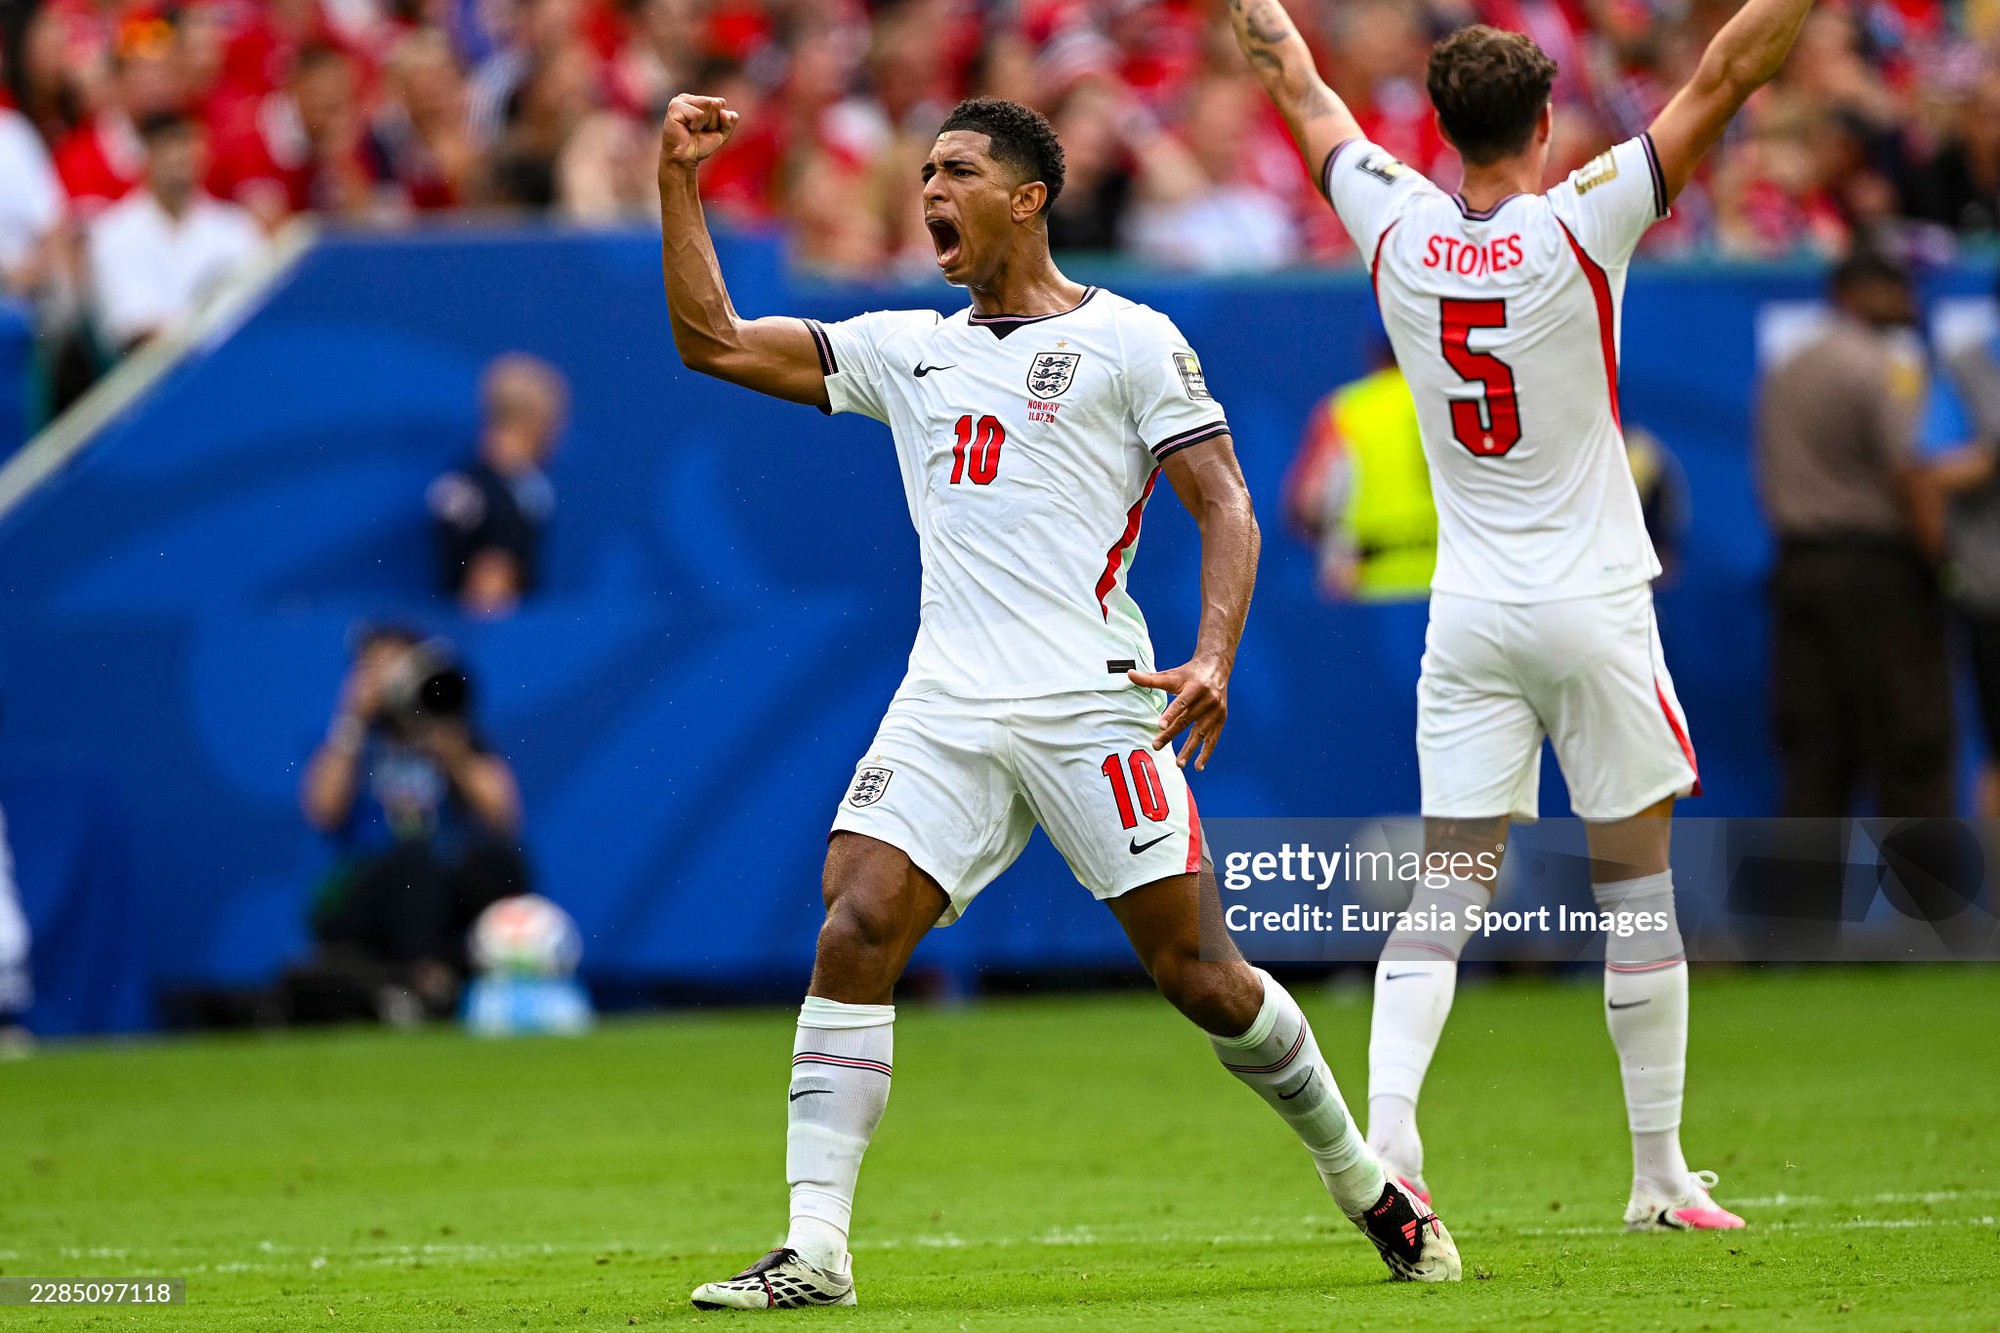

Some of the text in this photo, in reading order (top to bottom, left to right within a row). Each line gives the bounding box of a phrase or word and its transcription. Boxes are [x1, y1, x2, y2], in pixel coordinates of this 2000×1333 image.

[1027, 399, 1060, 413] NORWAY
[1440, 298, 1521, 456] 5
[950, 415, 1006, 485] 10
[1028, 411, 1055, 423] 11.07.26
[1102, 749, 1169, 830] 10
